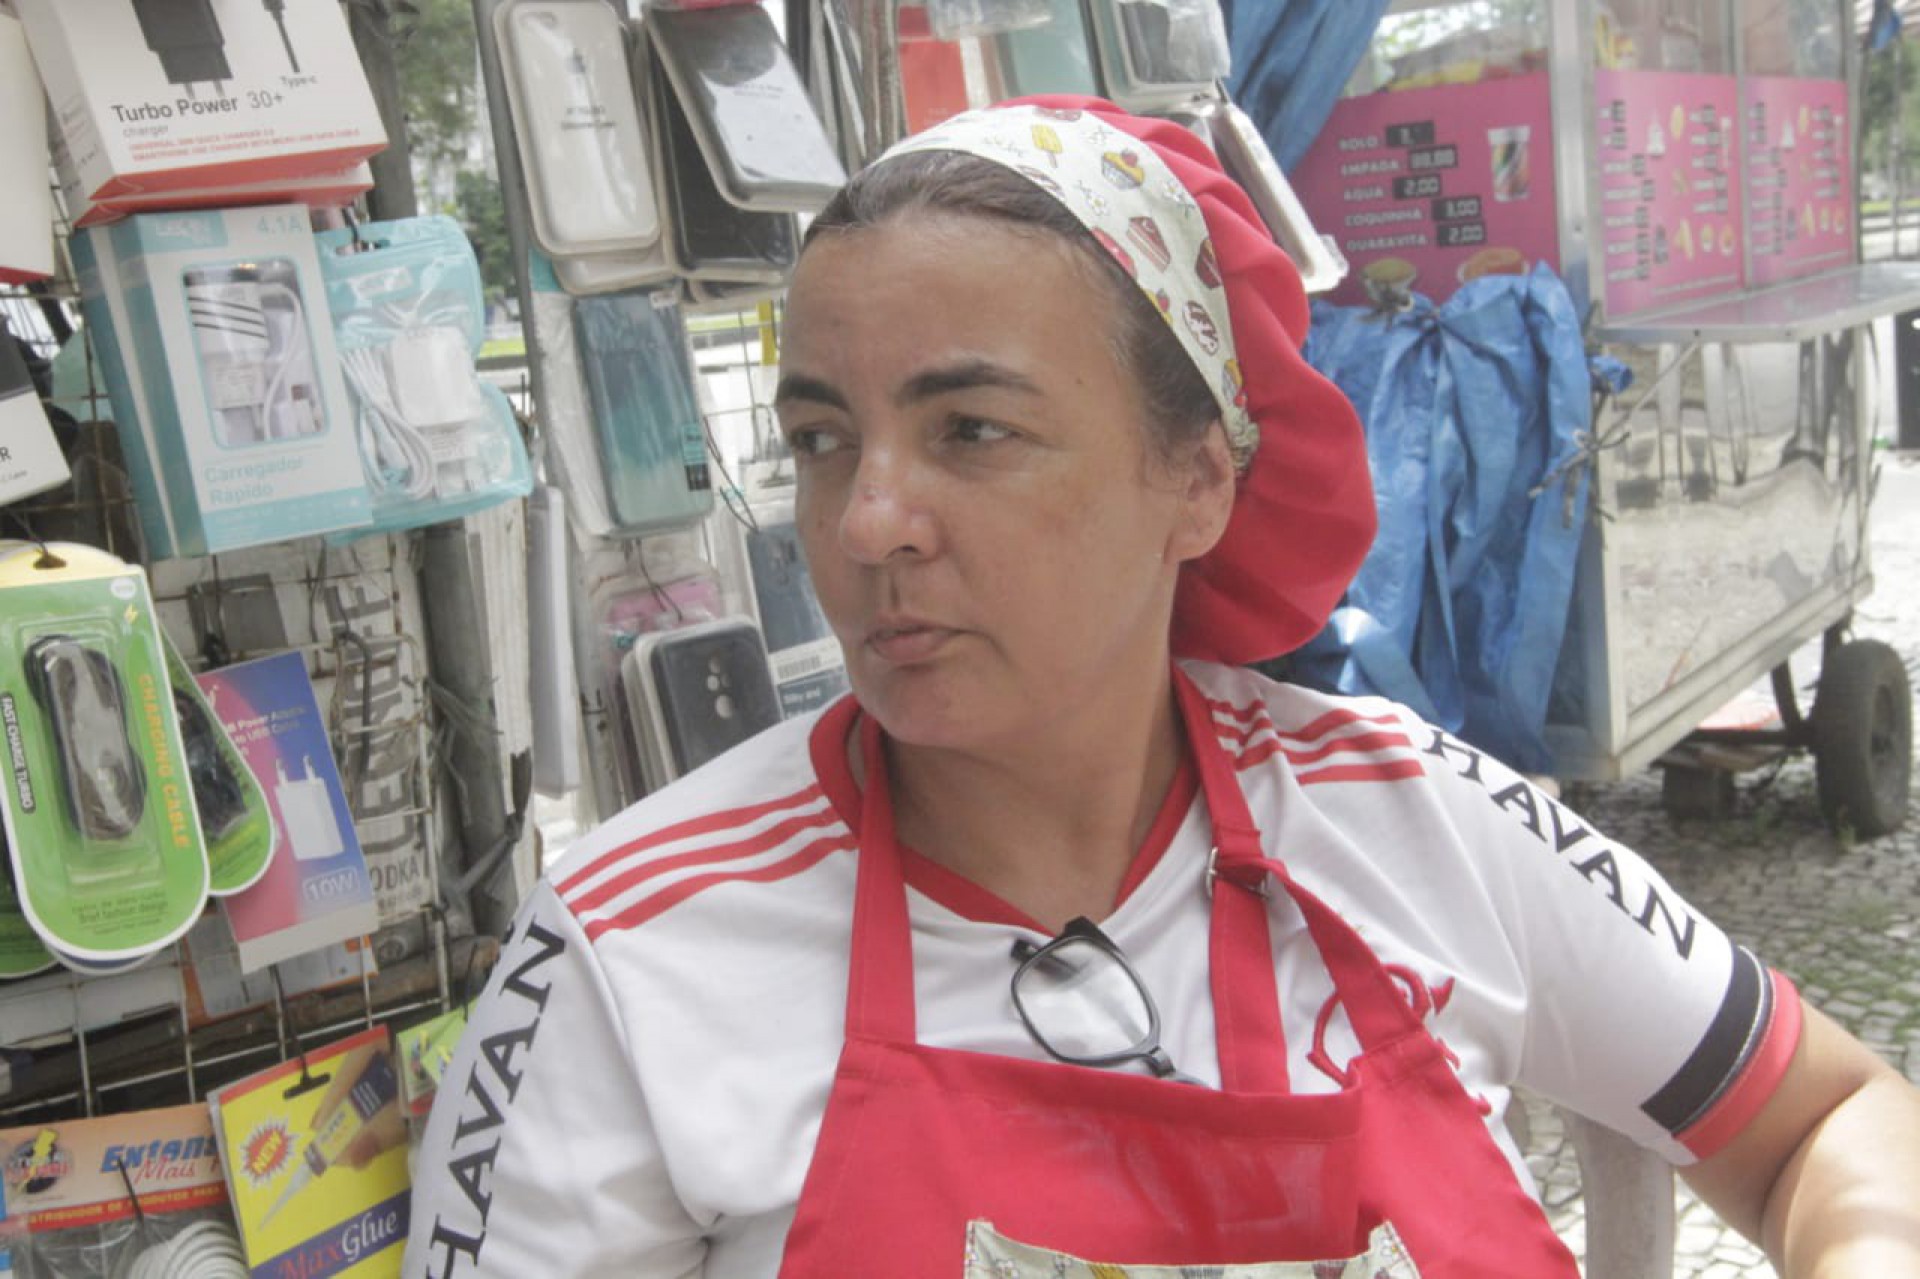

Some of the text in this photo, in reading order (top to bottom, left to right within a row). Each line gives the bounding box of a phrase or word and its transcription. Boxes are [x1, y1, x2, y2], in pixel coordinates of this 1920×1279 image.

[111, 90, 284, 122] Turbo Power 30+
[204, 455, 304, 483] Carregador
[7, 725, 25, 769] CHARGE
[16, 769, 34, 809] TURBO
[139, 674, 192, 849] CHARGING CABLE
[1423, 729, 1698, 961] HAVAN
[305, 869, 355, 901] 10W
[370, 855, 421, 891] ODKA
[426, 913, 566, 1279] HAVAN
[134, 1155, 195, 1185] Mais
[252, 1131, 282, 1174] NEW
